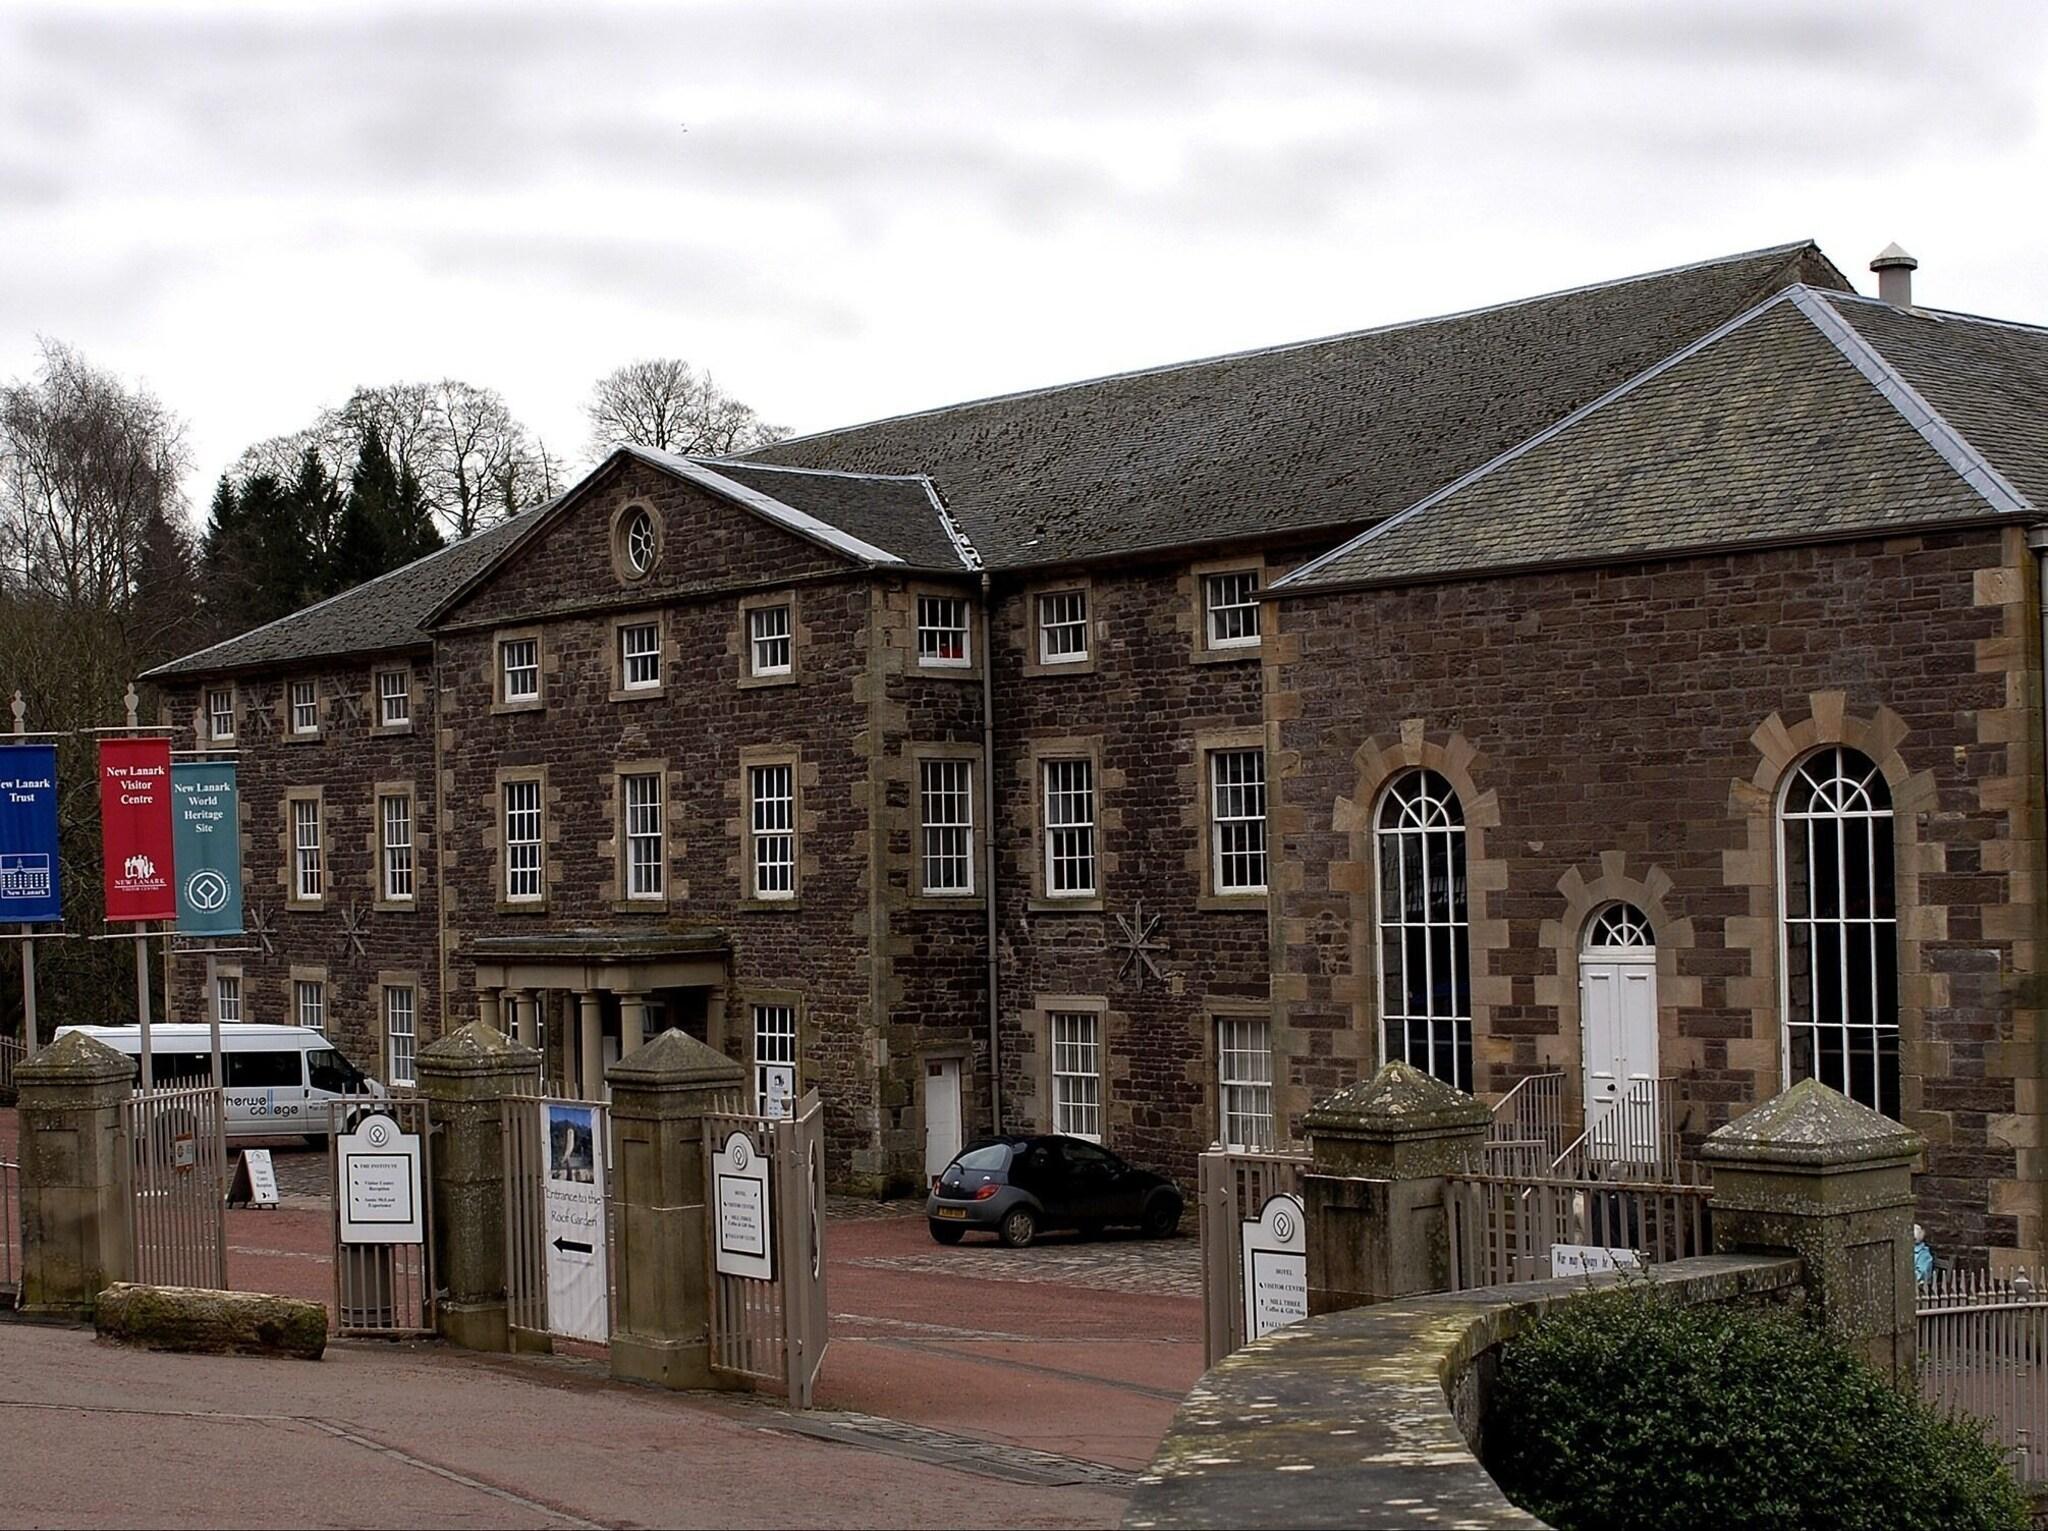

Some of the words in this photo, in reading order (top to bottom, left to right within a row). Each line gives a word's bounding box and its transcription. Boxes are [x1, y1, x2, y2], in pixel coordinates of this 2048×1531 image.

[106, 766, 128, 777] New
[129, 765, 165, 776] Lanark
[0, 779, 14, 789] ew
[16, 778, 51, 789] Lanark
[120, 780, 153, 791] Visitor
[174, 783, 195, 794] New
[196, 782, 231, 793] Lanark
[9, 792, 36, 803] Trust
[120, 794, 153, 806] Centre
[188, 796, 218, 806] World
[184, 810, 224, 821] Heritage
[195, 823, 214, 833] Site
[22, 888, 46, 896] Lanark
